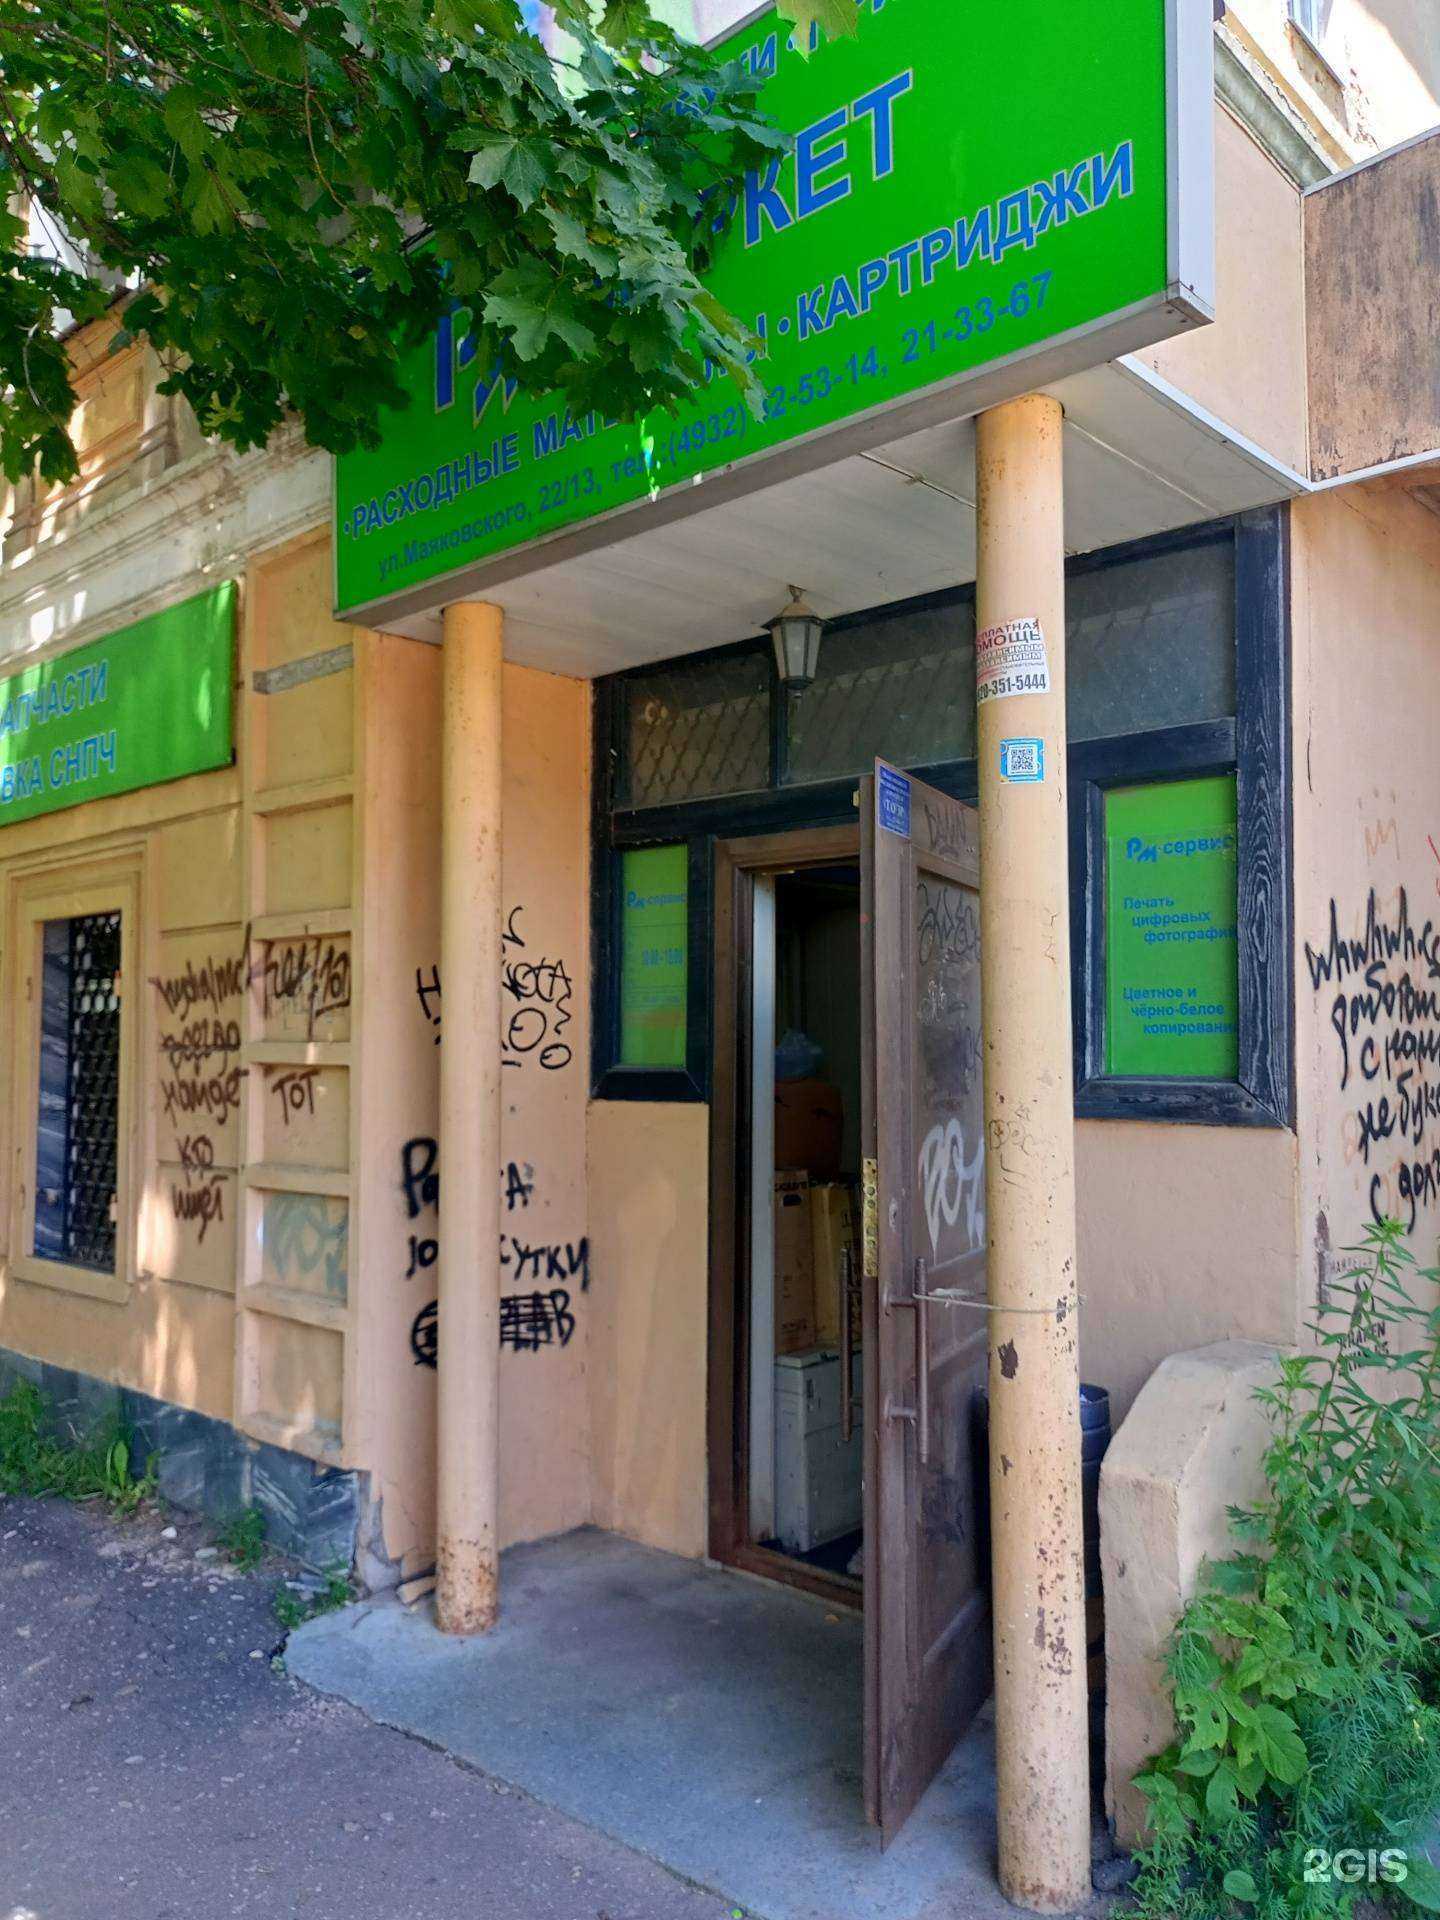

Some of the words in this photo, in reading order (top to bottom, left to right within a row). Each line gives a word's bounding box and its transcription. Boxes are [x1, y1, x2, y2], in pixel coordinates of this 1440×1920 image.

[797, 138, 1134, 341] КАРТРИДЖИ
[901, 269, 1054, 364] 21-33-67
[353, 431, 522, 540] РАСХОДНЫЕ
[50, 729, 117, 790] СНПЧ
[1123, 896, 1175, 910] Печать
[1132, 911, 1211, 928] цифровых
[1123, 986, 1183, 1001] Цветное
[1187, 988, 1197, 998] и
[1131, 1001, 1225, 1019] чёрно-белое
